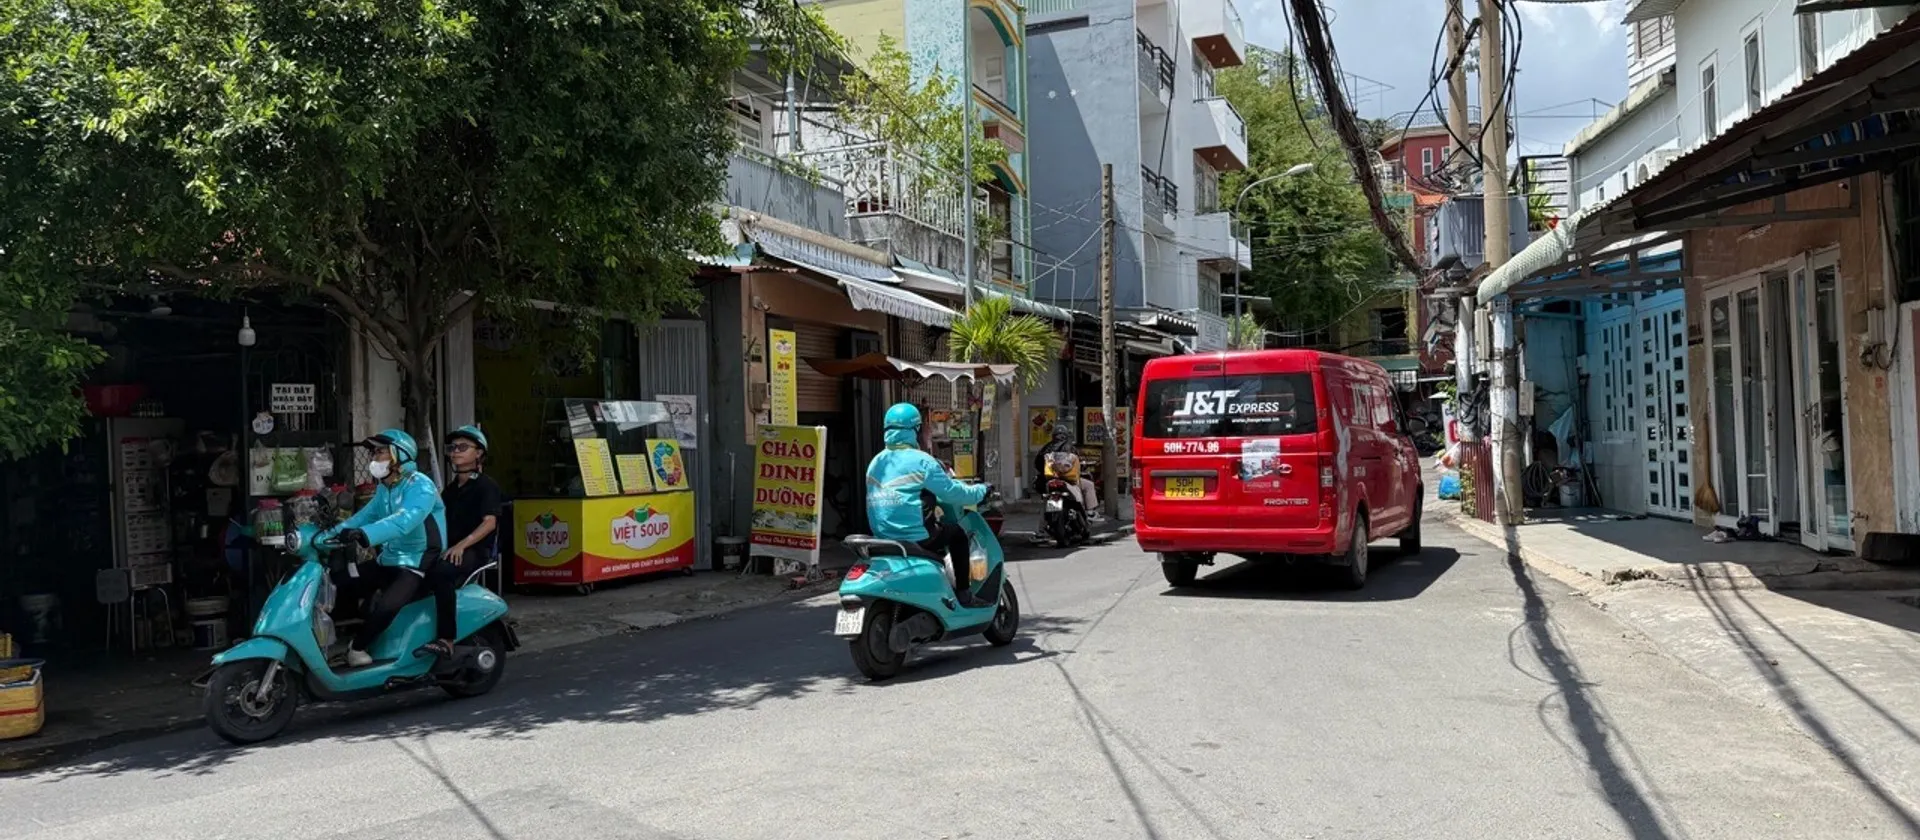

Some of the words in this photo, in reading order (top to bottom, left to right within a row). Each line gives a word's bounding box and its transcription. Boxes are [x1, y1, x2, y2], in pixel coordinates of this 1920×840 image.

[1172, 389, 1240, 416] J&T
[1228, 402, 1280, 414] EXPRESS
[761, 439, 816, 459] CHÁO
[1163, 440, 1220, 453] 50H-774.96
[759, 463, 816, 482] DINH
[1176, 478, 1193, 487] 50H
[756, 485, 816, 507] DƯỠNG
[1263, 498, 1309, 506] FRONTIER
[526, 527, 546, 549] VIỆT
[546, 530, 568, 546] SOUP
[613, 522, 637, 543] VIỆT
[640, 522, 669, 537] SOUP
